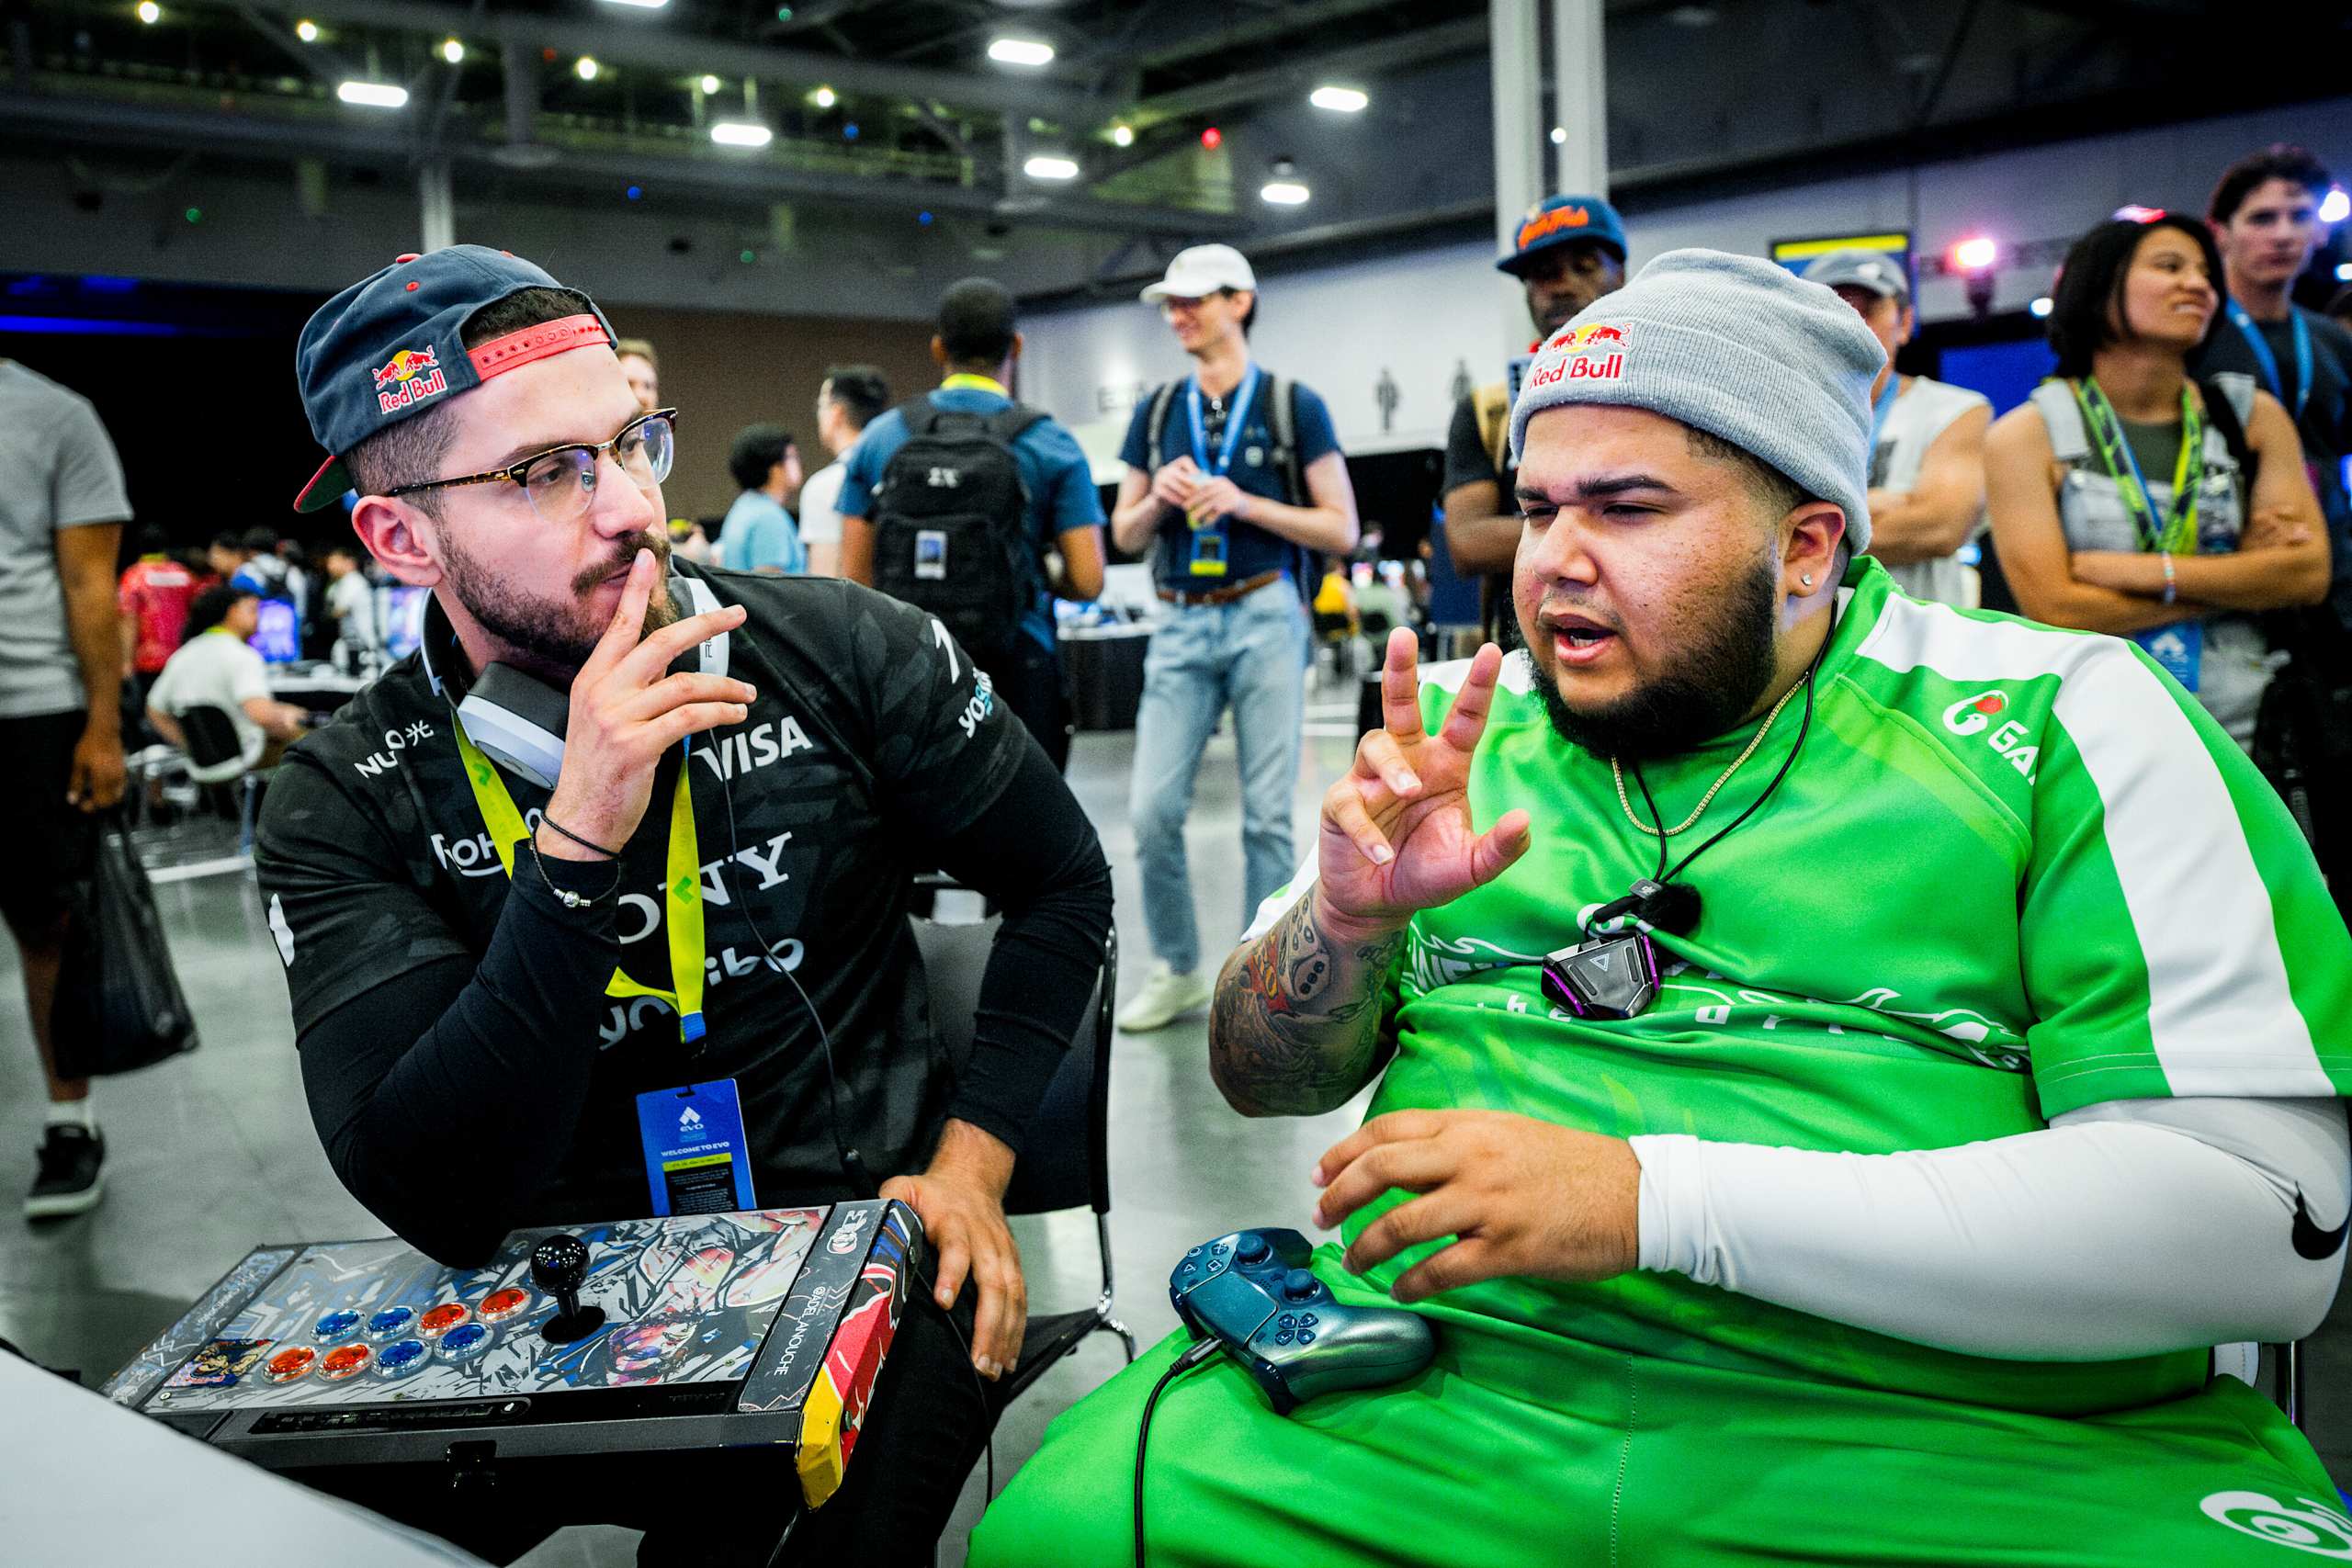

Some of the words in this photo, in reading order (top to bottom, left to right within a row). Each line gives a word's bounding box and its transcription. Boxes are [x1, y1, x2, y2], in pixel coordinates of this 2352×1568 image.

[379, 381, 413, 413] Red
[409, 368, 447, 400] Bull
[1529, 357, 1568, 389] Red
[1570, 354, 1623, 378] Bull
[691, 716, 813, 782] VISA
[1988, 720, 2040, 786] GA
[662, 1146, 701, 1156] WELCOME
[713, 1141, 730, 1150] EVO
[774, 1286, 826, 1376] @ADEL_ANOUCHE
